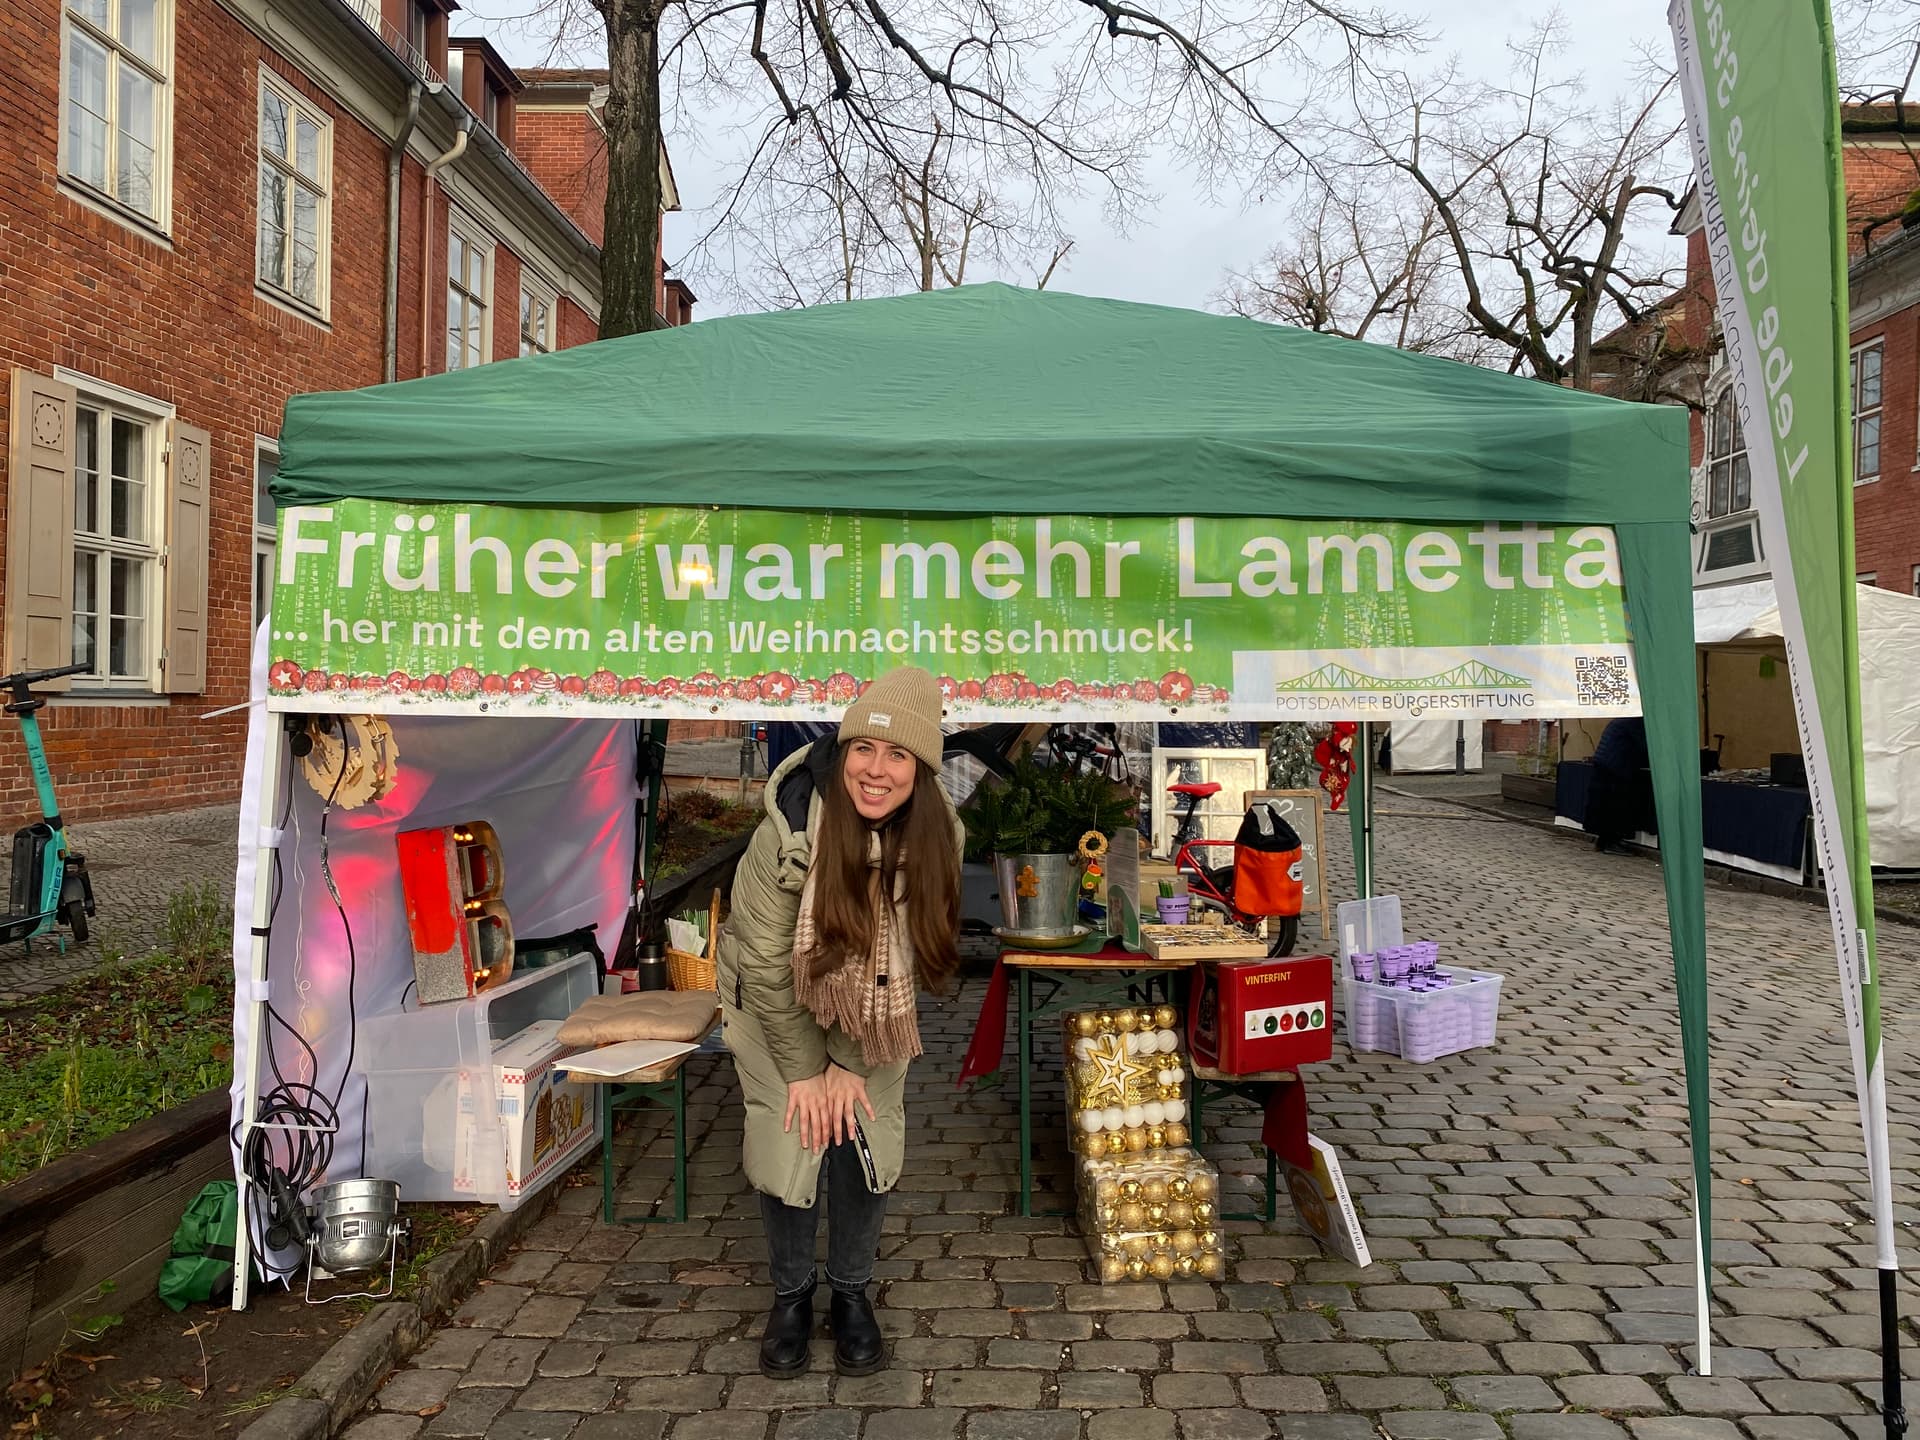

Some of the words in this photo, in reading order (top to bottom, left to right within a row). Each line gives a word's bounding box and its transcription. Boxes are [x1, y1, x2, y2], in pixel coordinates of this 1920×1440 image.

[279, 507, 622, 599] Früher
[655, 541, 843, 601] war
[880, 517, 1141, 599] mehr
[1178, 518, 1624, 597] Lametta
[322, 609, 396, 645] her
[412, 613, 483, 648] mit
[498, 616, 590, 652] dem
[604, 621, 713, 654] alten
[728, 618, 1194, 655] Weihnachtsschmuck!
[1276, 696, 1379, 711] POTSDAMER
[1382, 692, 1535, 711] BÜRGERSTIFTUNG
[50, 866, 62, 902] TIER
[1244, 971, 1292, 986] VINTERFINT
